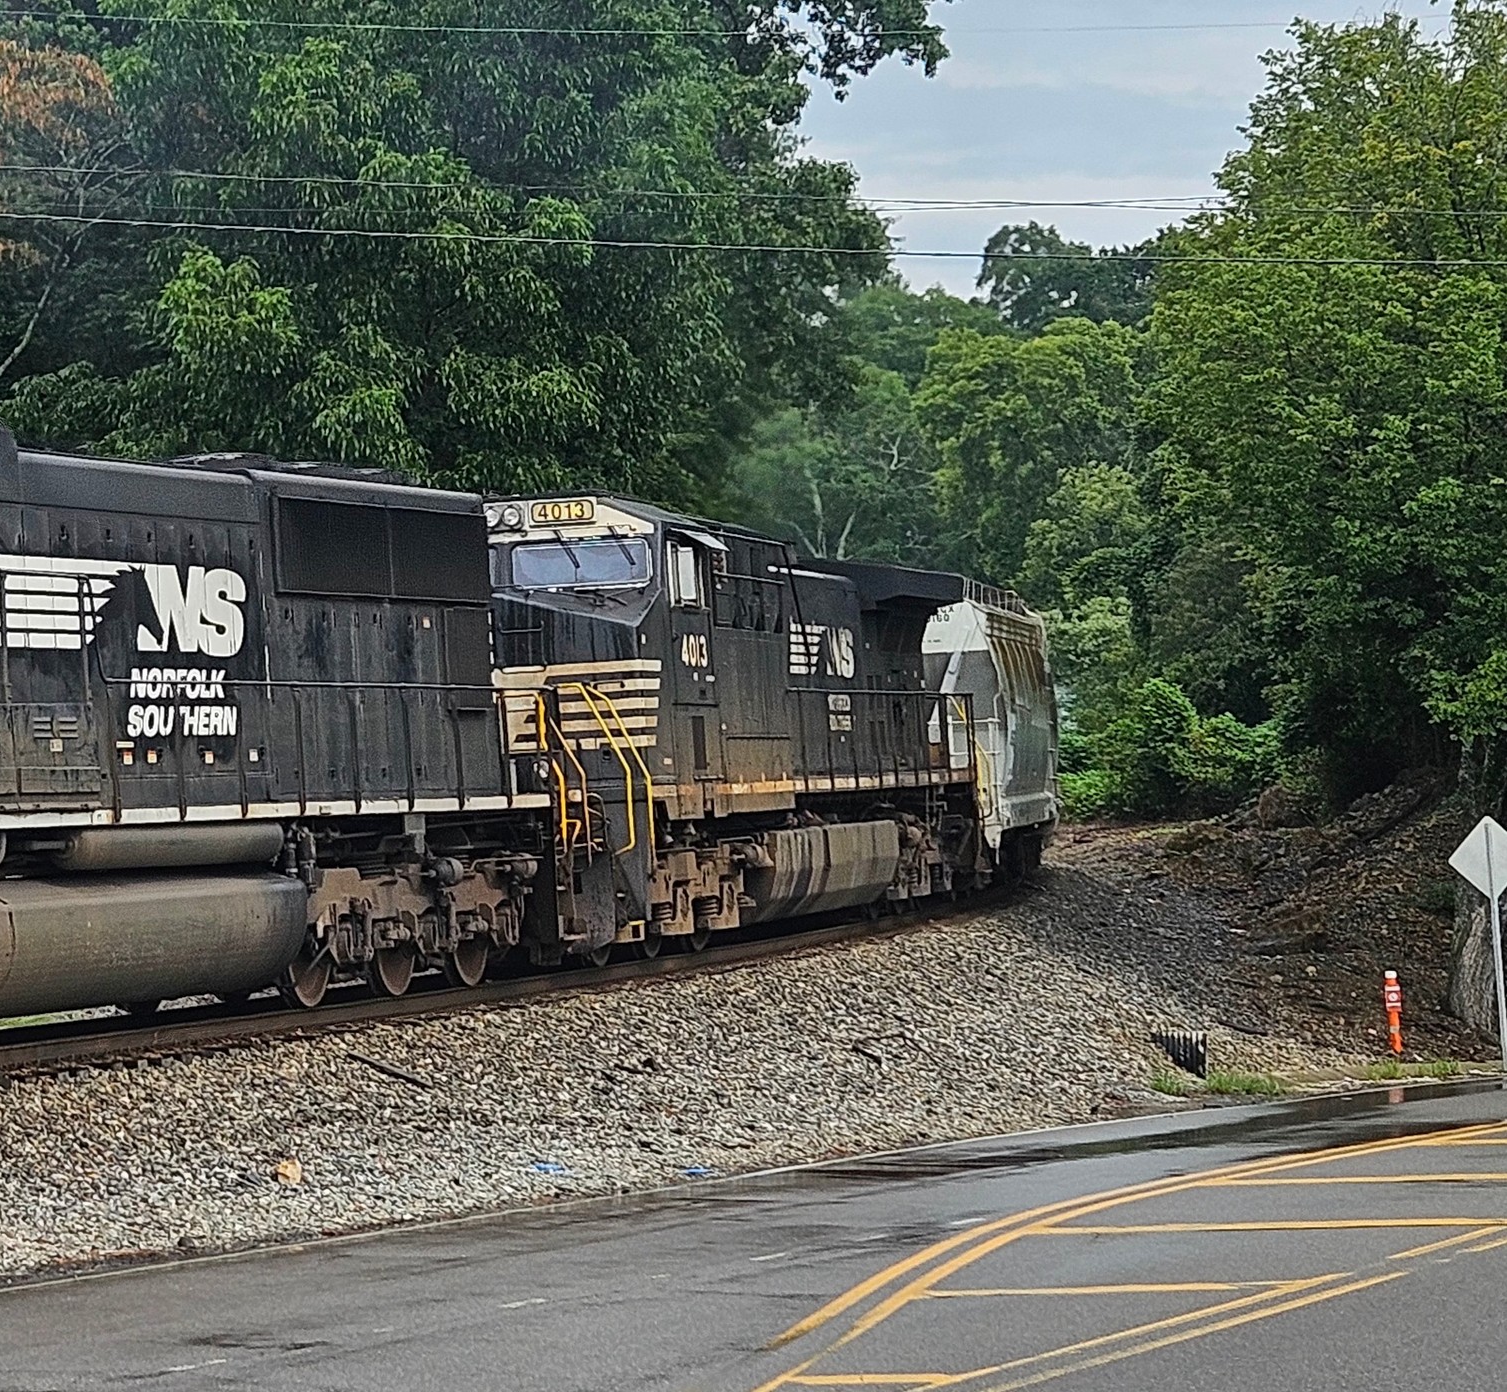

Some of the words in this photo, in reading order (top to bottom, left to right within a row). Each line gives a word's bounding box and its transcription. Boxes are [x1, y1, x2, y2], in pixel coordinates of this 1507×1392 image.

[538, 502, 585, 520] 4013
[137, 564, 247, 658] NS
[681, 633, 708, 668] 4013
[129, 667, 226, 699] NORFOLK
